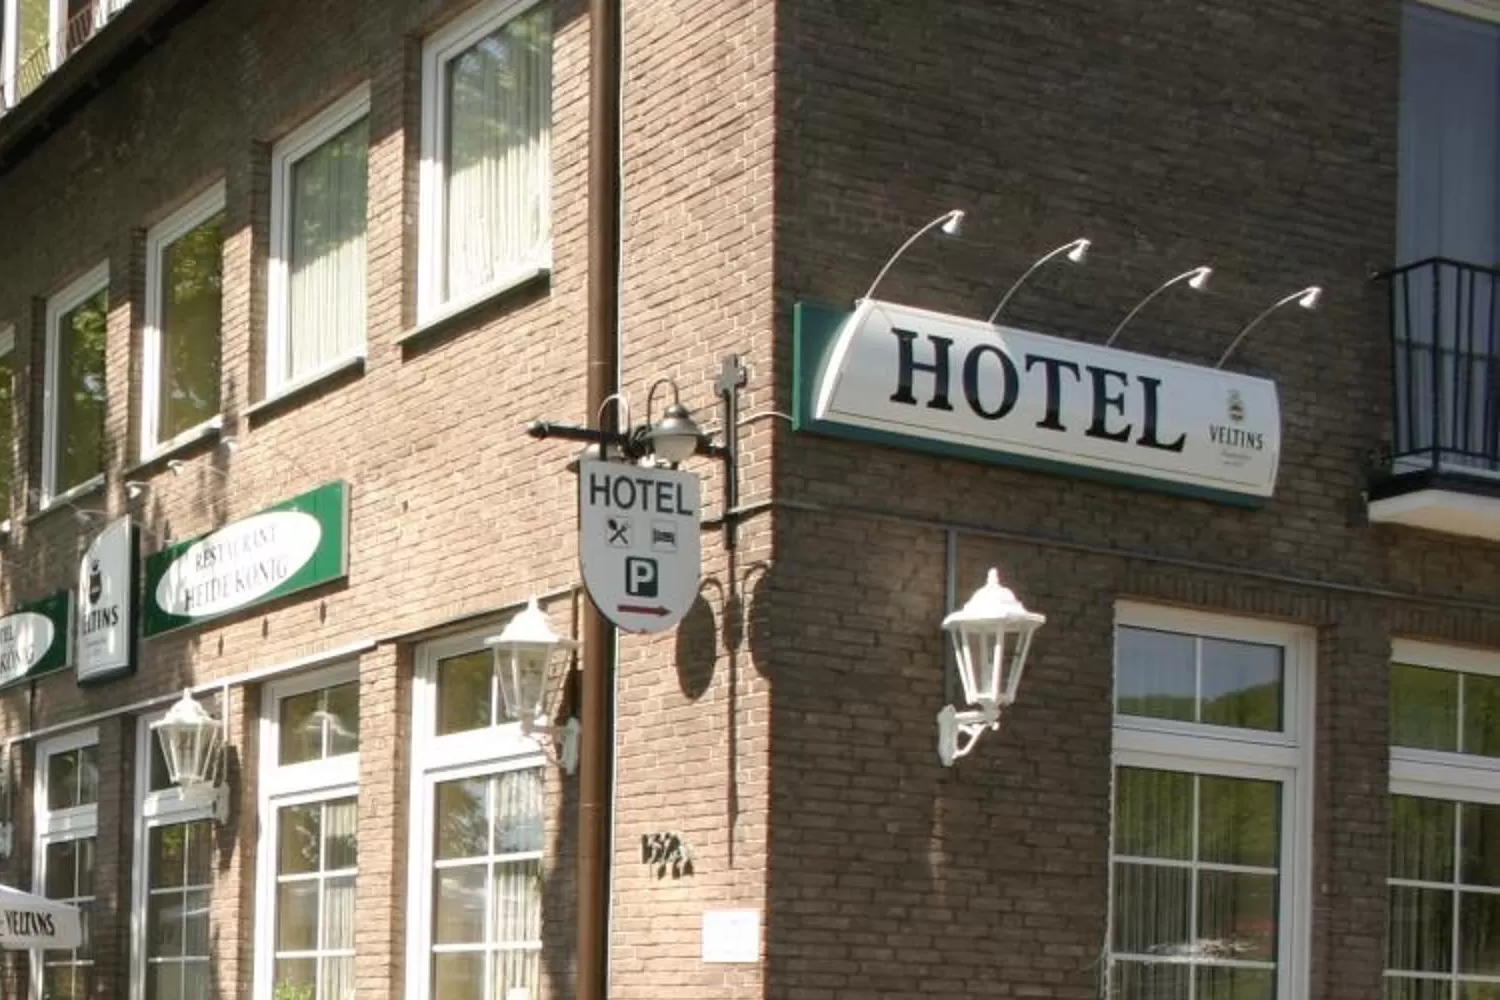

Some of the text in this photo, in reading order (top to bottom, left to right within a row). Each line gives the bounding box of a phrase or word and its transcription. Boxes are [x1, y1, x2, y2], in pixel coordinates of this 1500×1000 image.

[889, 327, 1187, 453] HOTEL
[1209, 422, 1263, 451] VELTINS
[589, 473, 693, 517] HOTEL
[184, 573, 229, 612] HEIDE
[629, 560, 654, 592] P
[4, 907, 55, 937] VELTINS
